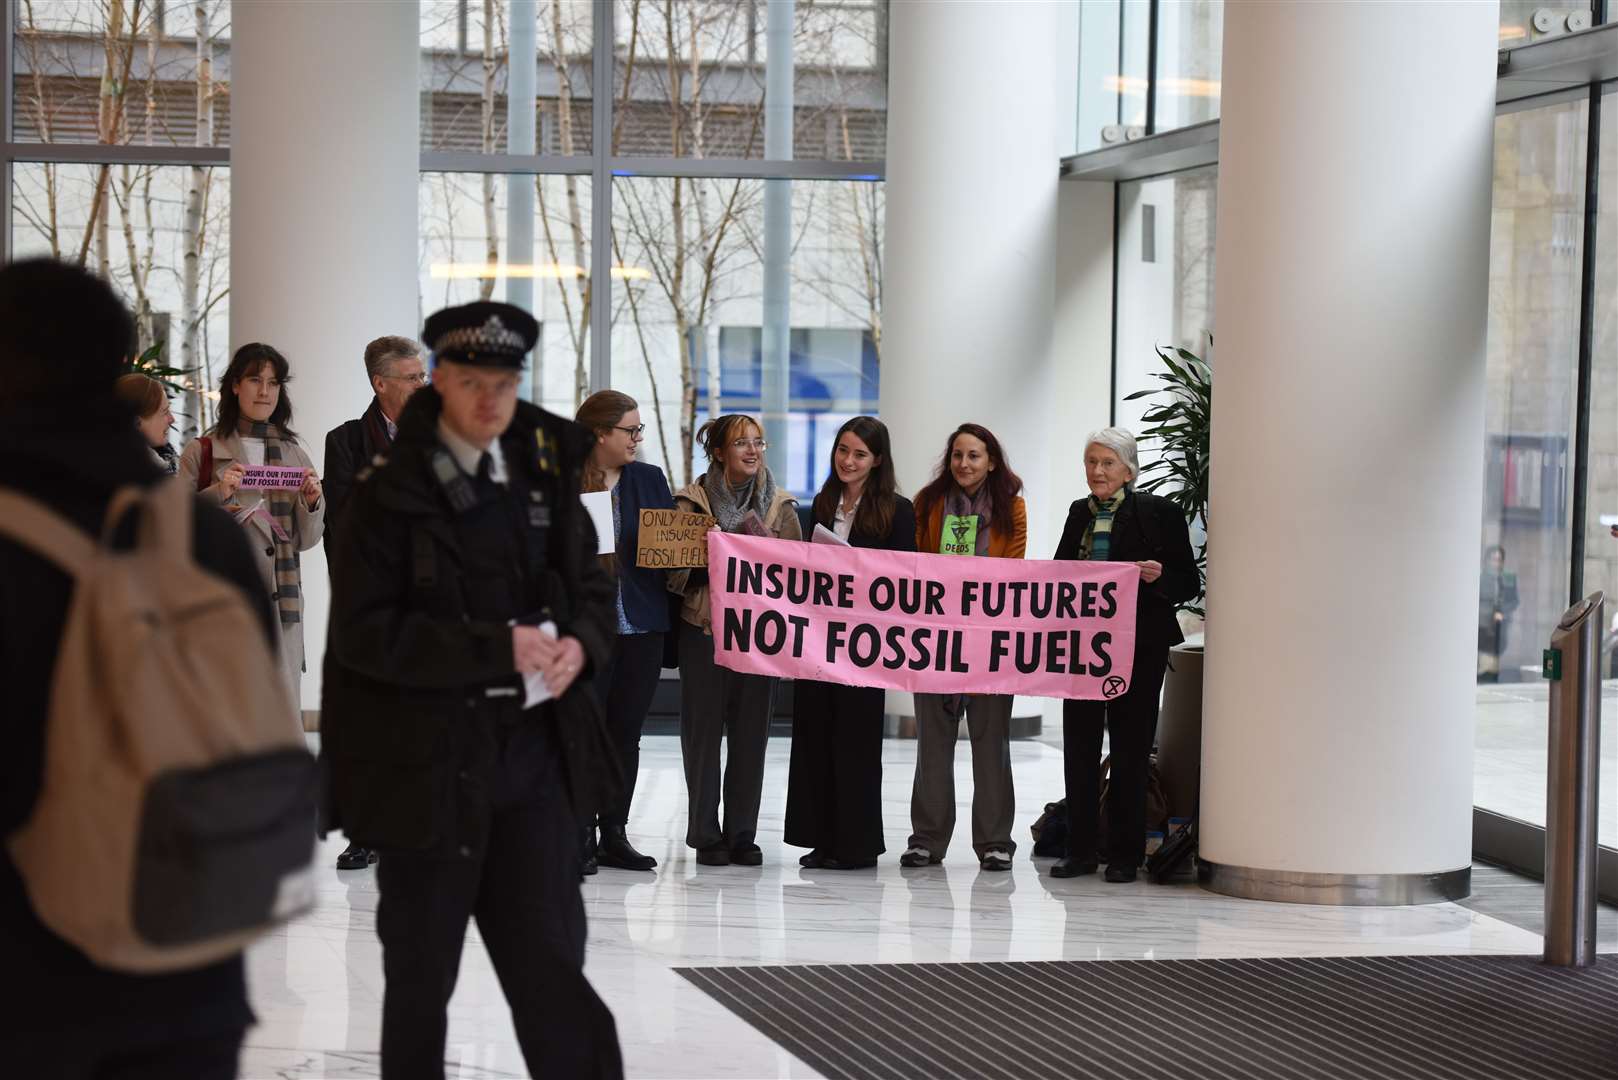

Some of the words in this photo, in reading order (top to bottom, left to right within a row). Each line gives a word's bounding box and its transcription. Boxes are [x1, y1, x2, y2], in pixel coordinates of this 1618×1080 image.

[242, 478, 257, 486] NOT
[258, 478, 280, 487] FOSSIL
[282, 479, 301, 487] FUELS
[245, 470, 265, 478] NSURE
[266, 470, 279, 478] OUR
[642, 510, 677, 527] ONLY
[680, 514, 715, 527] FOOLS
[656, 529, 697, 542] INSURE
[638, 548, 677, 566] FOSSIL
[726, 556, 854, 608] INSURE
[868, 576, 946, 616] OUR
[961, 581, 1118, 619] FUTURES
[723, 607, 810, 658] NOT
[826, 621, 969, 673] FOSSIL
[988, 630, 1113, 677] FUELS
